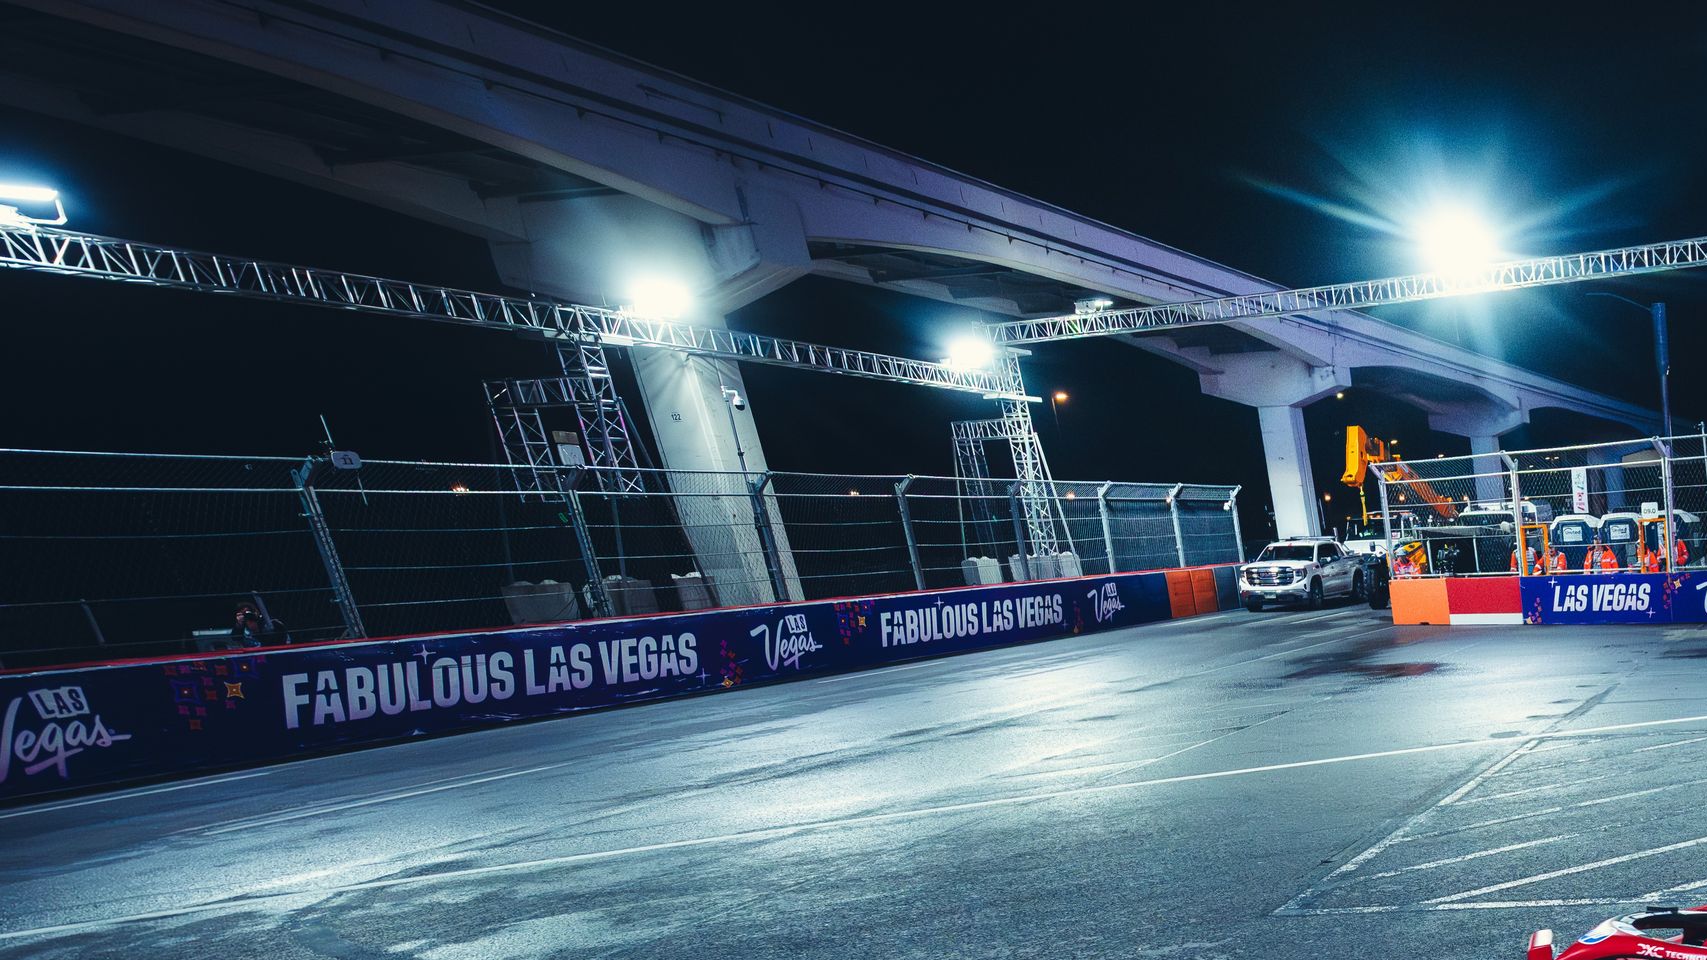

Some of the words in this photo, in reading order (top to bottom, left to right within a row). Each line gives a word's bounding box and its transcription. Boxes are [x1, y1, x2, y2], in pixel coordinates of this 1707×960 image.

[671, 413, 682, 421] 122
[1087, 586, 1125, 623] Vegas
[1553, 584, 1588, 612] LAS
[1592, 583, 1652, 612] VEGAS
[787, 614, 807, 633] LAS
[880, 604, 979, 648] FABULOUS
[982, 600, 1014, 633] LAS
[1017, 594, 1063, 628] VEGAS
[750, 615, 823, 672] Vegas
[282, 651, 516, 729] FABULOUS
[524, 642, 594, 696] LAS
[598, 632, 699, 686] VEGAS
[38, 687, 87, 716] LAS
